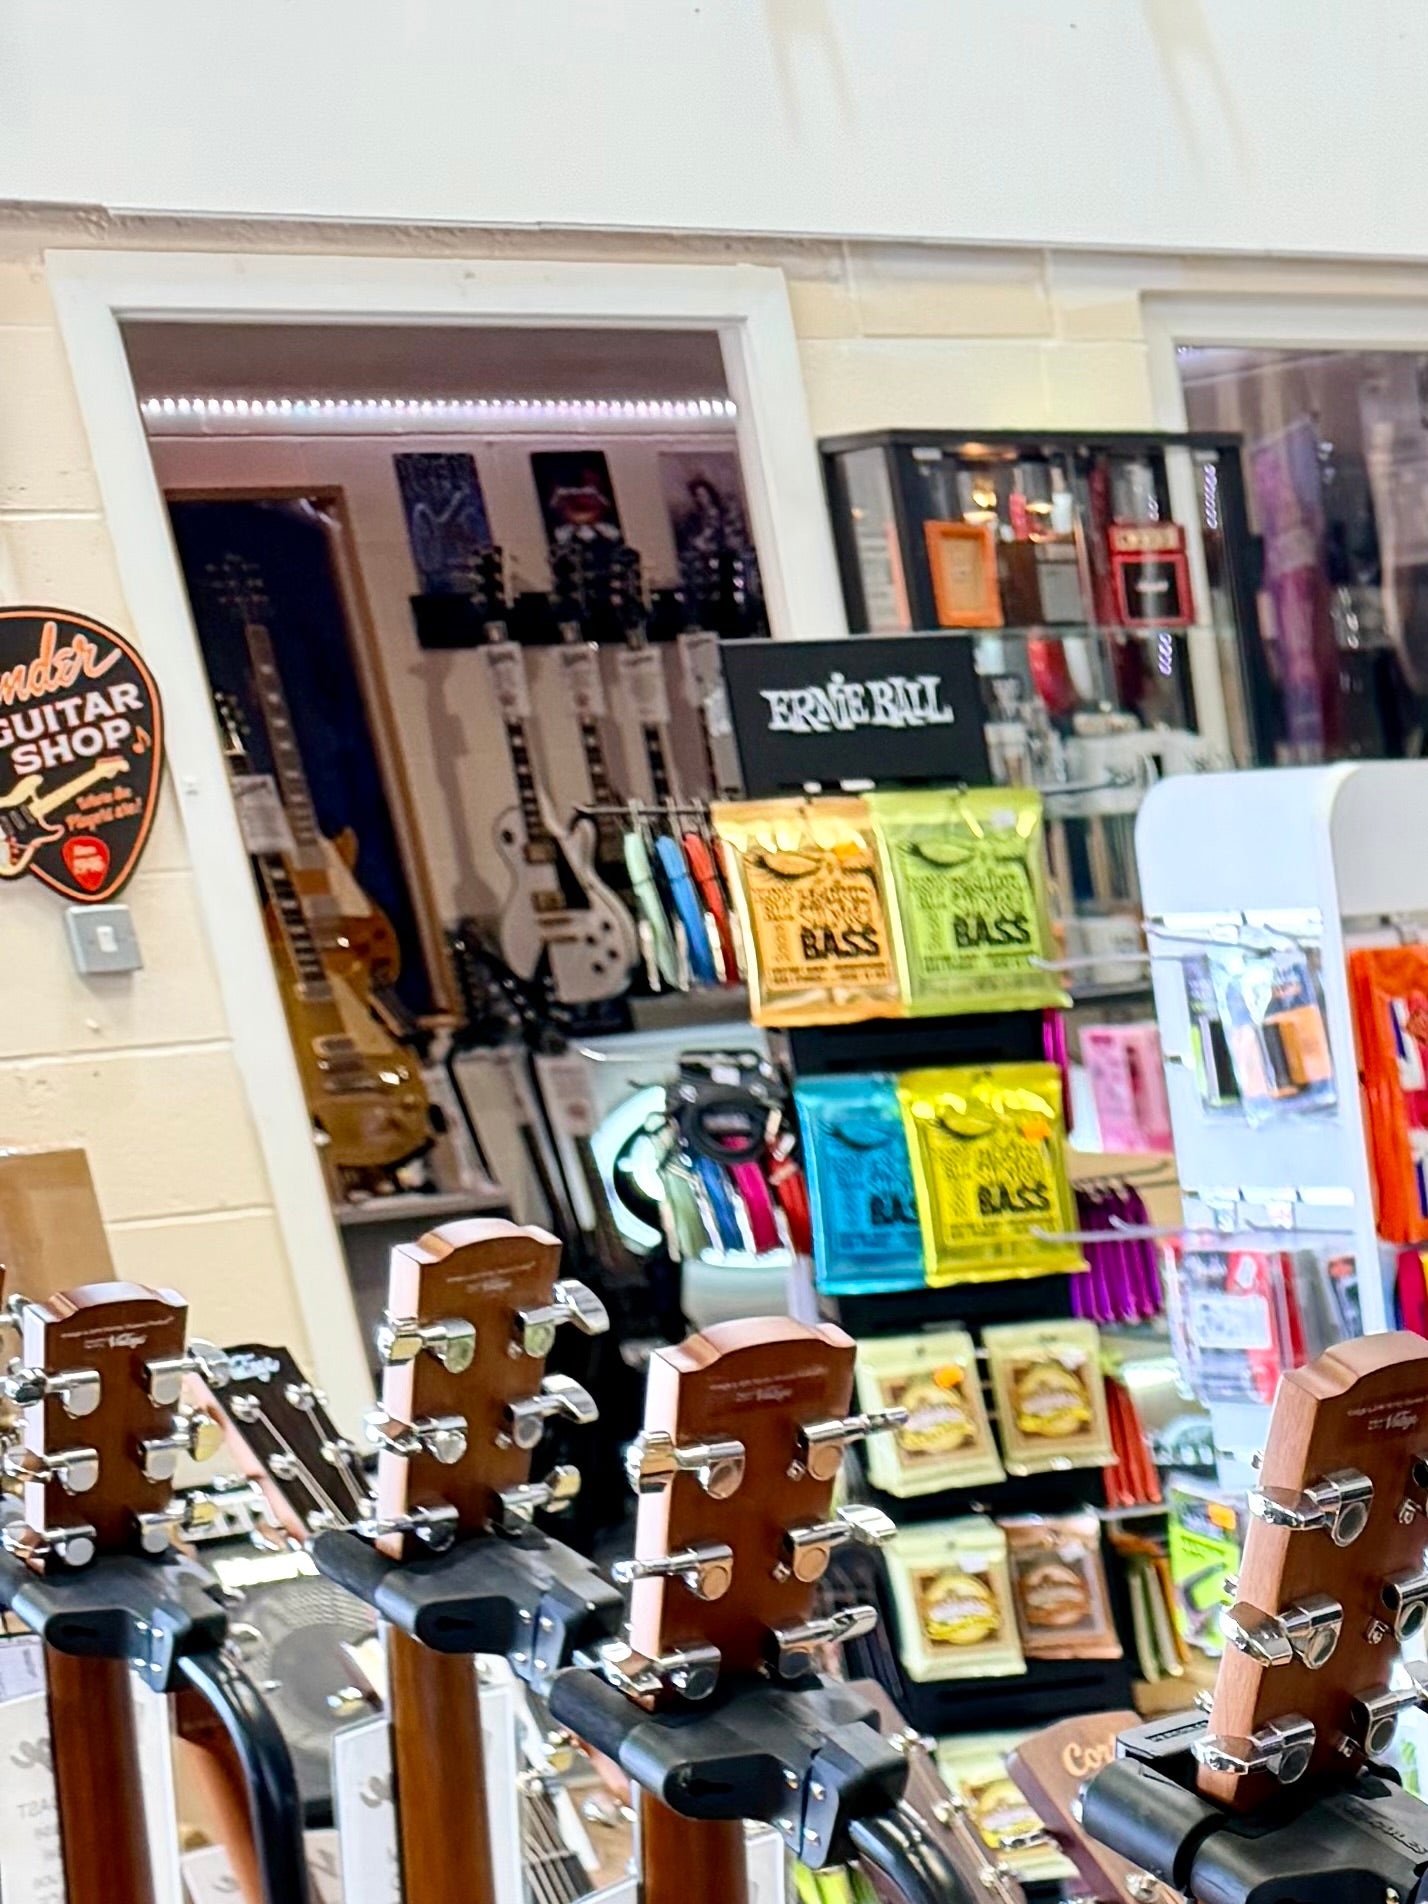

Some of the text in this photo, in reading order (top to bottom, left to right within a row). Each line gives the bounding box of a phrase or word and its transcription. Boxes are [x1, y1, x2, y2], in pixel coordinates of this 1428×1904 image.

[868, 674, 955, 728] BALL
[11, 718, 132, 776] SHOP
[801, 924, 881, 961] BASS
[954, 912, 1032, 948] BASS
[976, 1180, 1053, 1218] BASS
